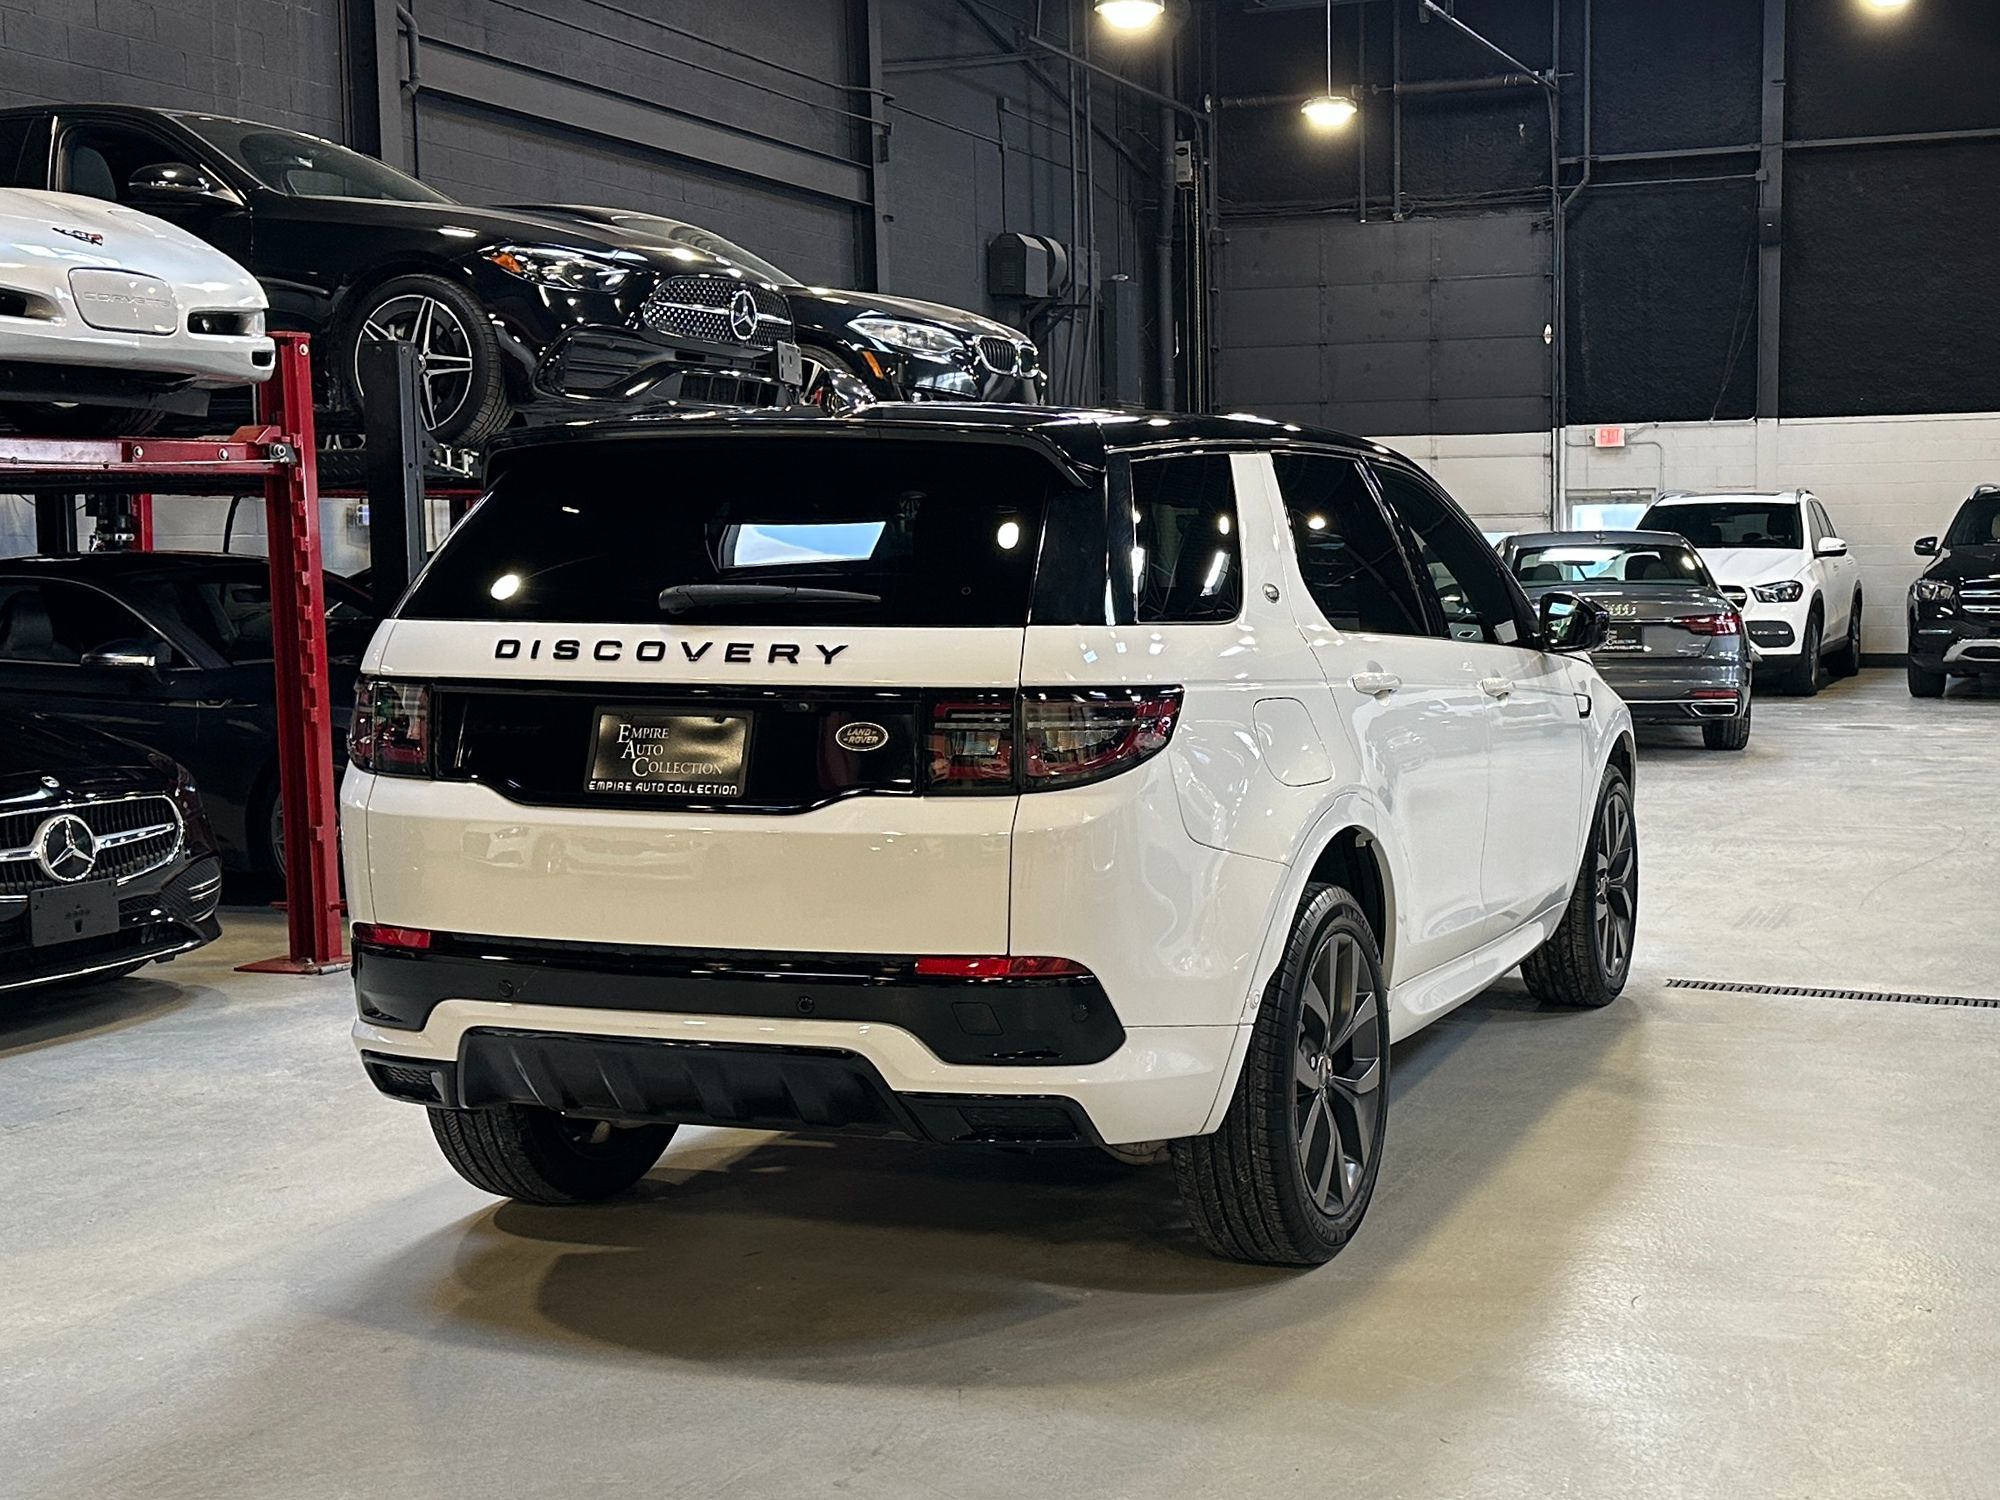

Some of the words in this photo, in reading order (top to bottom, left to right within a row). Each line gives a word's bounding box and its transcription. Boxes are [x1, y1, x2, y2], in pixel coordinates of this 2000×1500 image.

[495, 639, 849, 665] DISCOVERY
[616, 723, 670, 744] EMPIRE
[620, 740, 664, 759] AUTO
[632, 756, 723, 777] COLLECTION
[588, 780, 632, 791] EMPIRE
[635, 782, 665, 793] AUTO
[667, 783, 738, 795] COLLECTION
